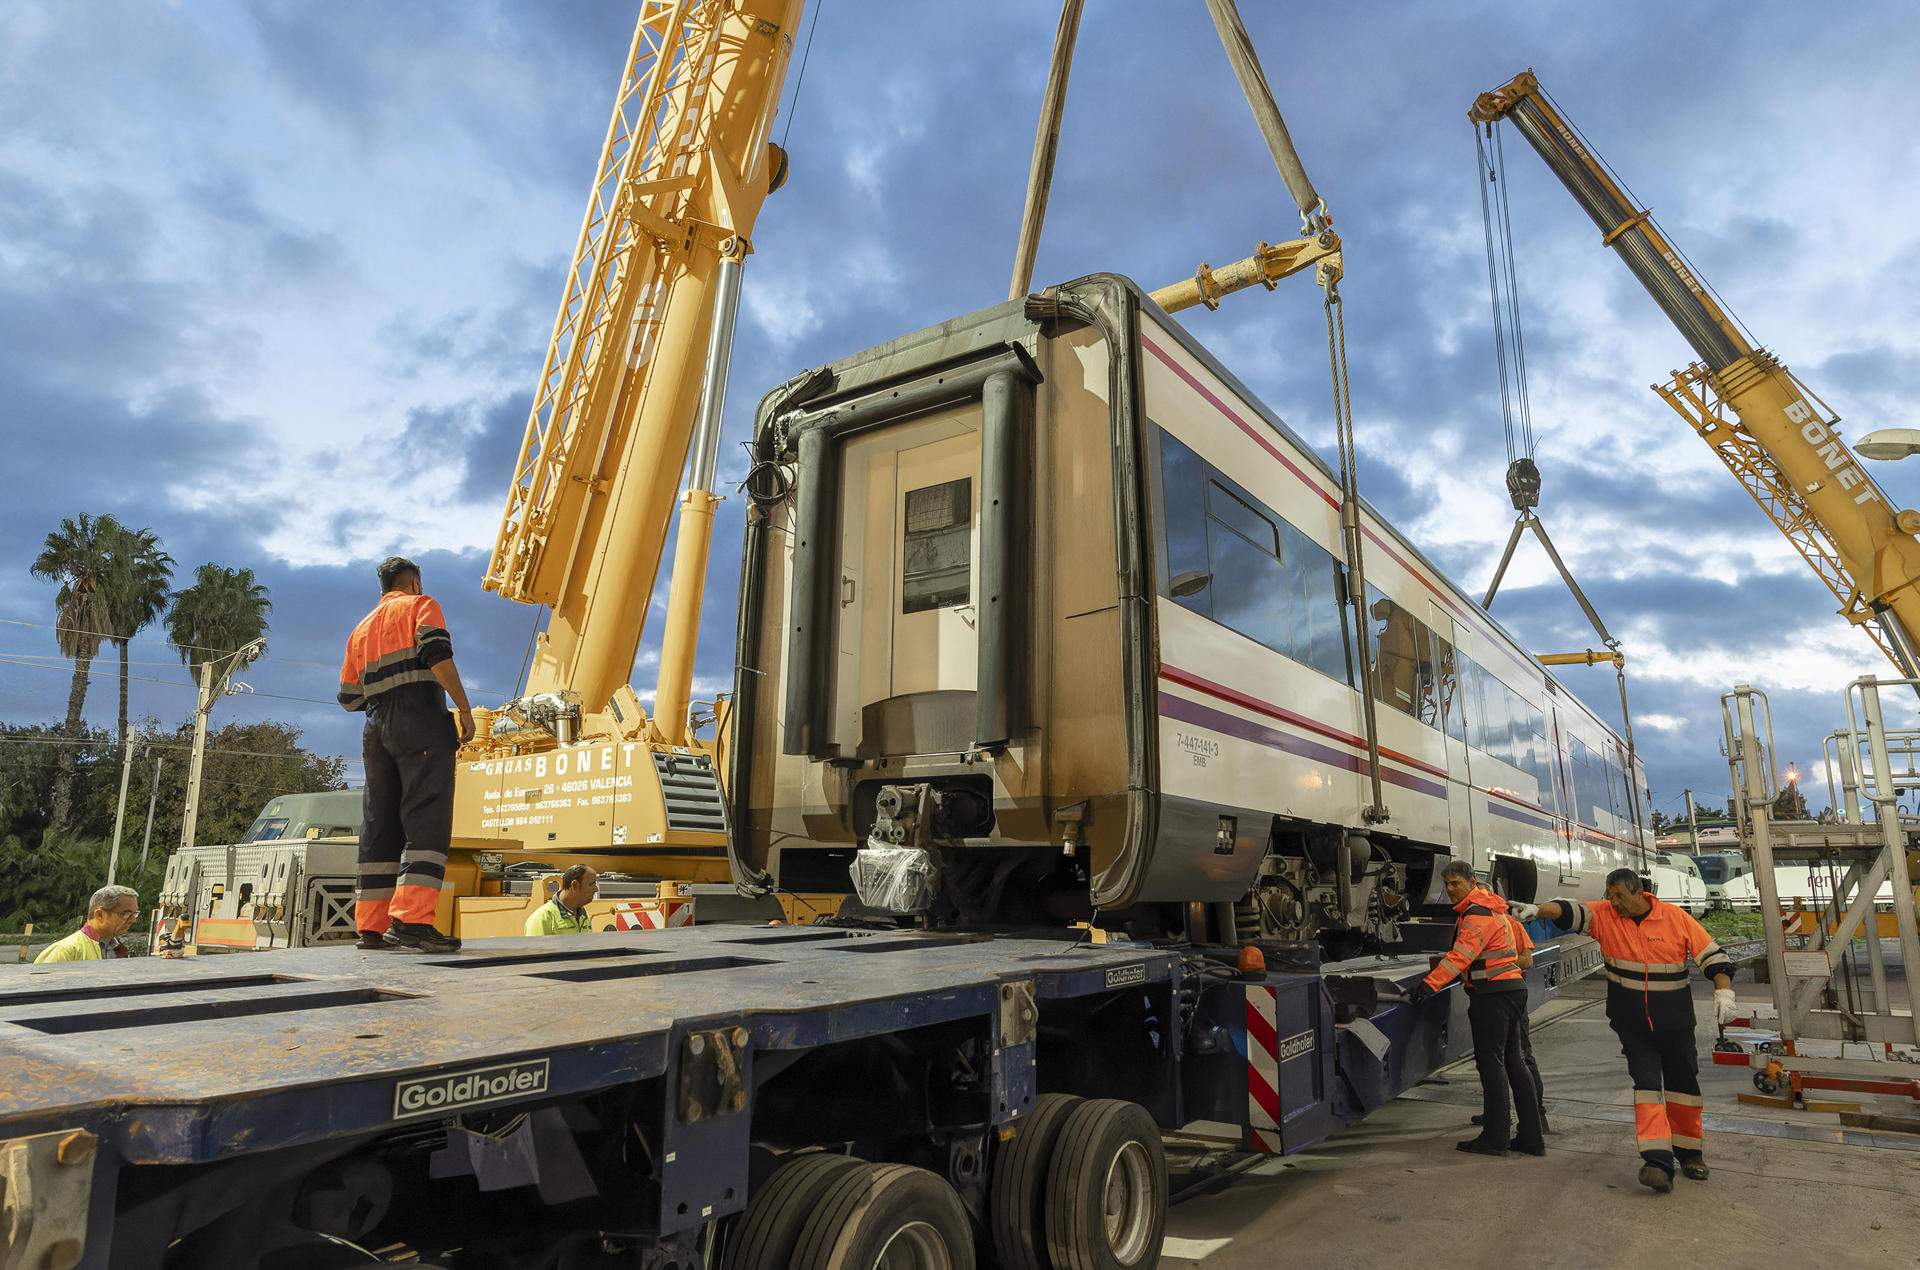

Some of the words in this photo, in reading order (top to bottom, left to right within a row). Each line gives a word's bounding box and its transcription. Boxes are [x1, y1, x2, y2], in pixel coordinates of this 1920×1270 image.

[1783, 399, 1879, 504] BONET
[535, 744, 635, 777] BONET
[590, 775, 632, 790] VALENCIA
[401, 1068, 544, 1110] Goldhofer
